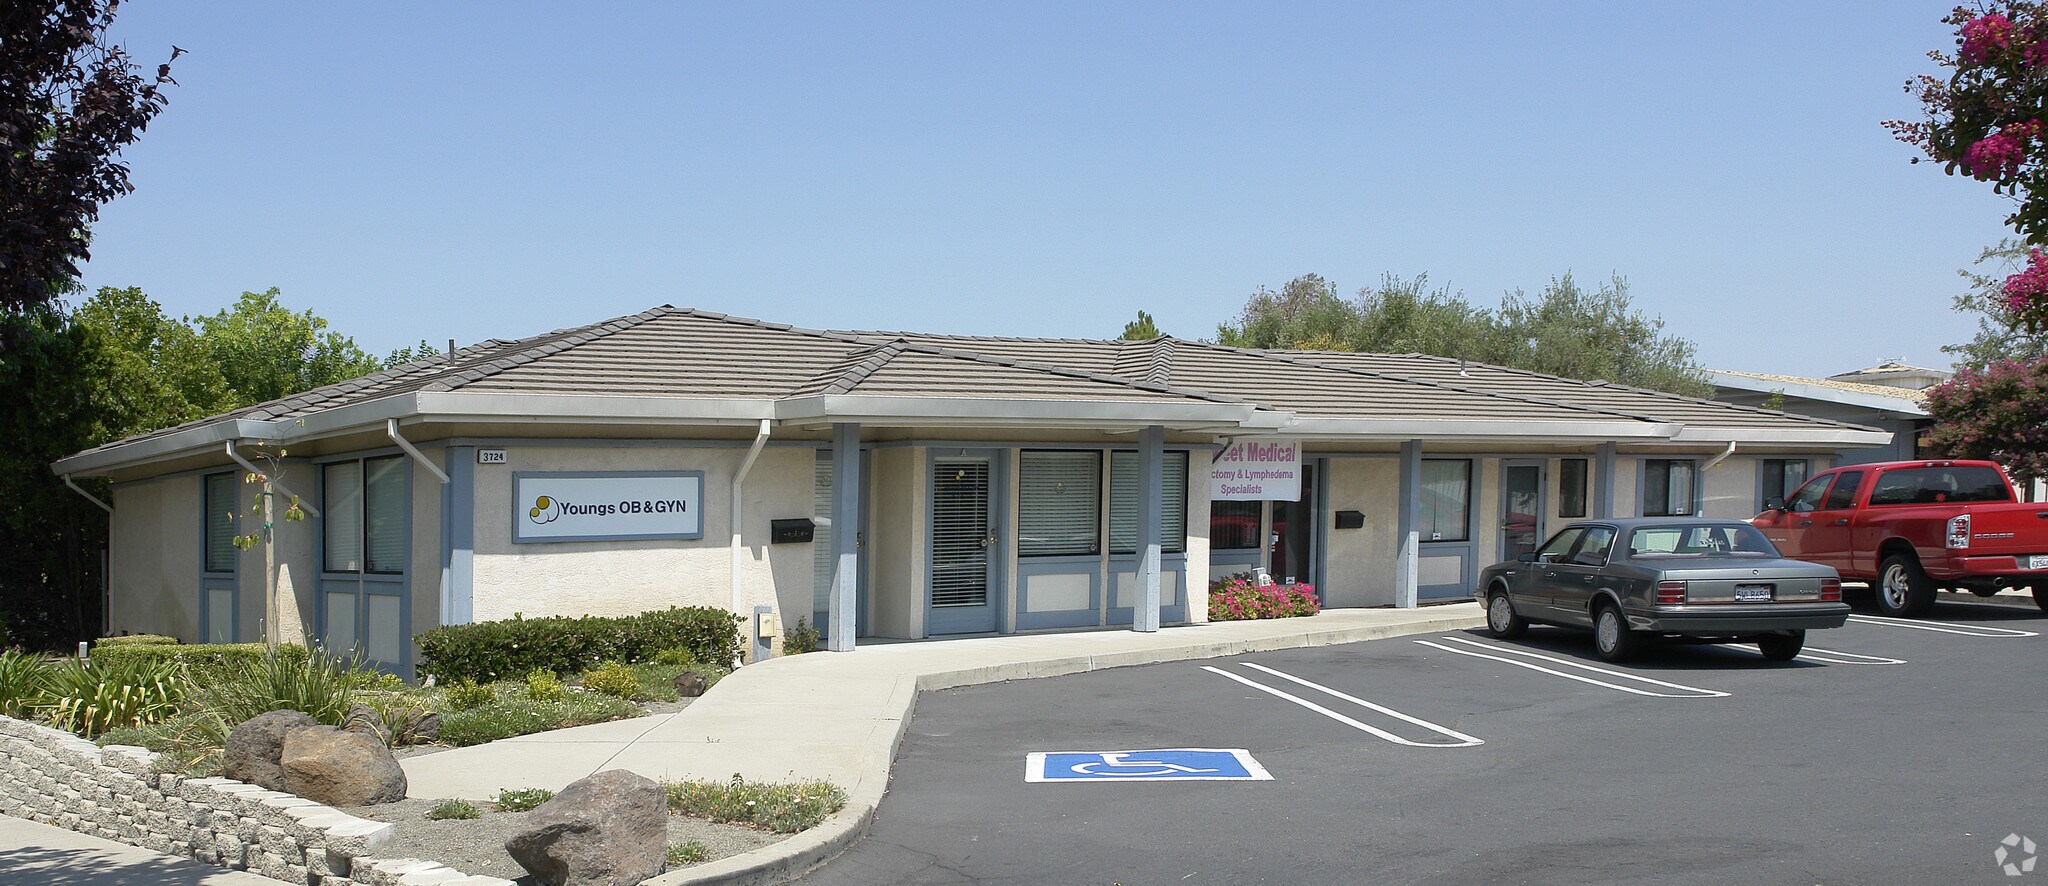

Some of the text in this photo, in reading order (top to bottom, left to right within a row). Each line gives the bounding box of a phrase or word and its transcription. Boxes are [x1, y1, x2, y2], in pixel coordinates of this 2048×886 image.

[483, 452, 504, 461] 3724
[1212, 442, 1296, 462] eet Medical
[1237, 469, 1243, 479] &
[1245, 469, 1294, 481] Lymphedema
[1220, 484, 1262, 496] Specialists
[560, 502, 616, 516] Youngs
